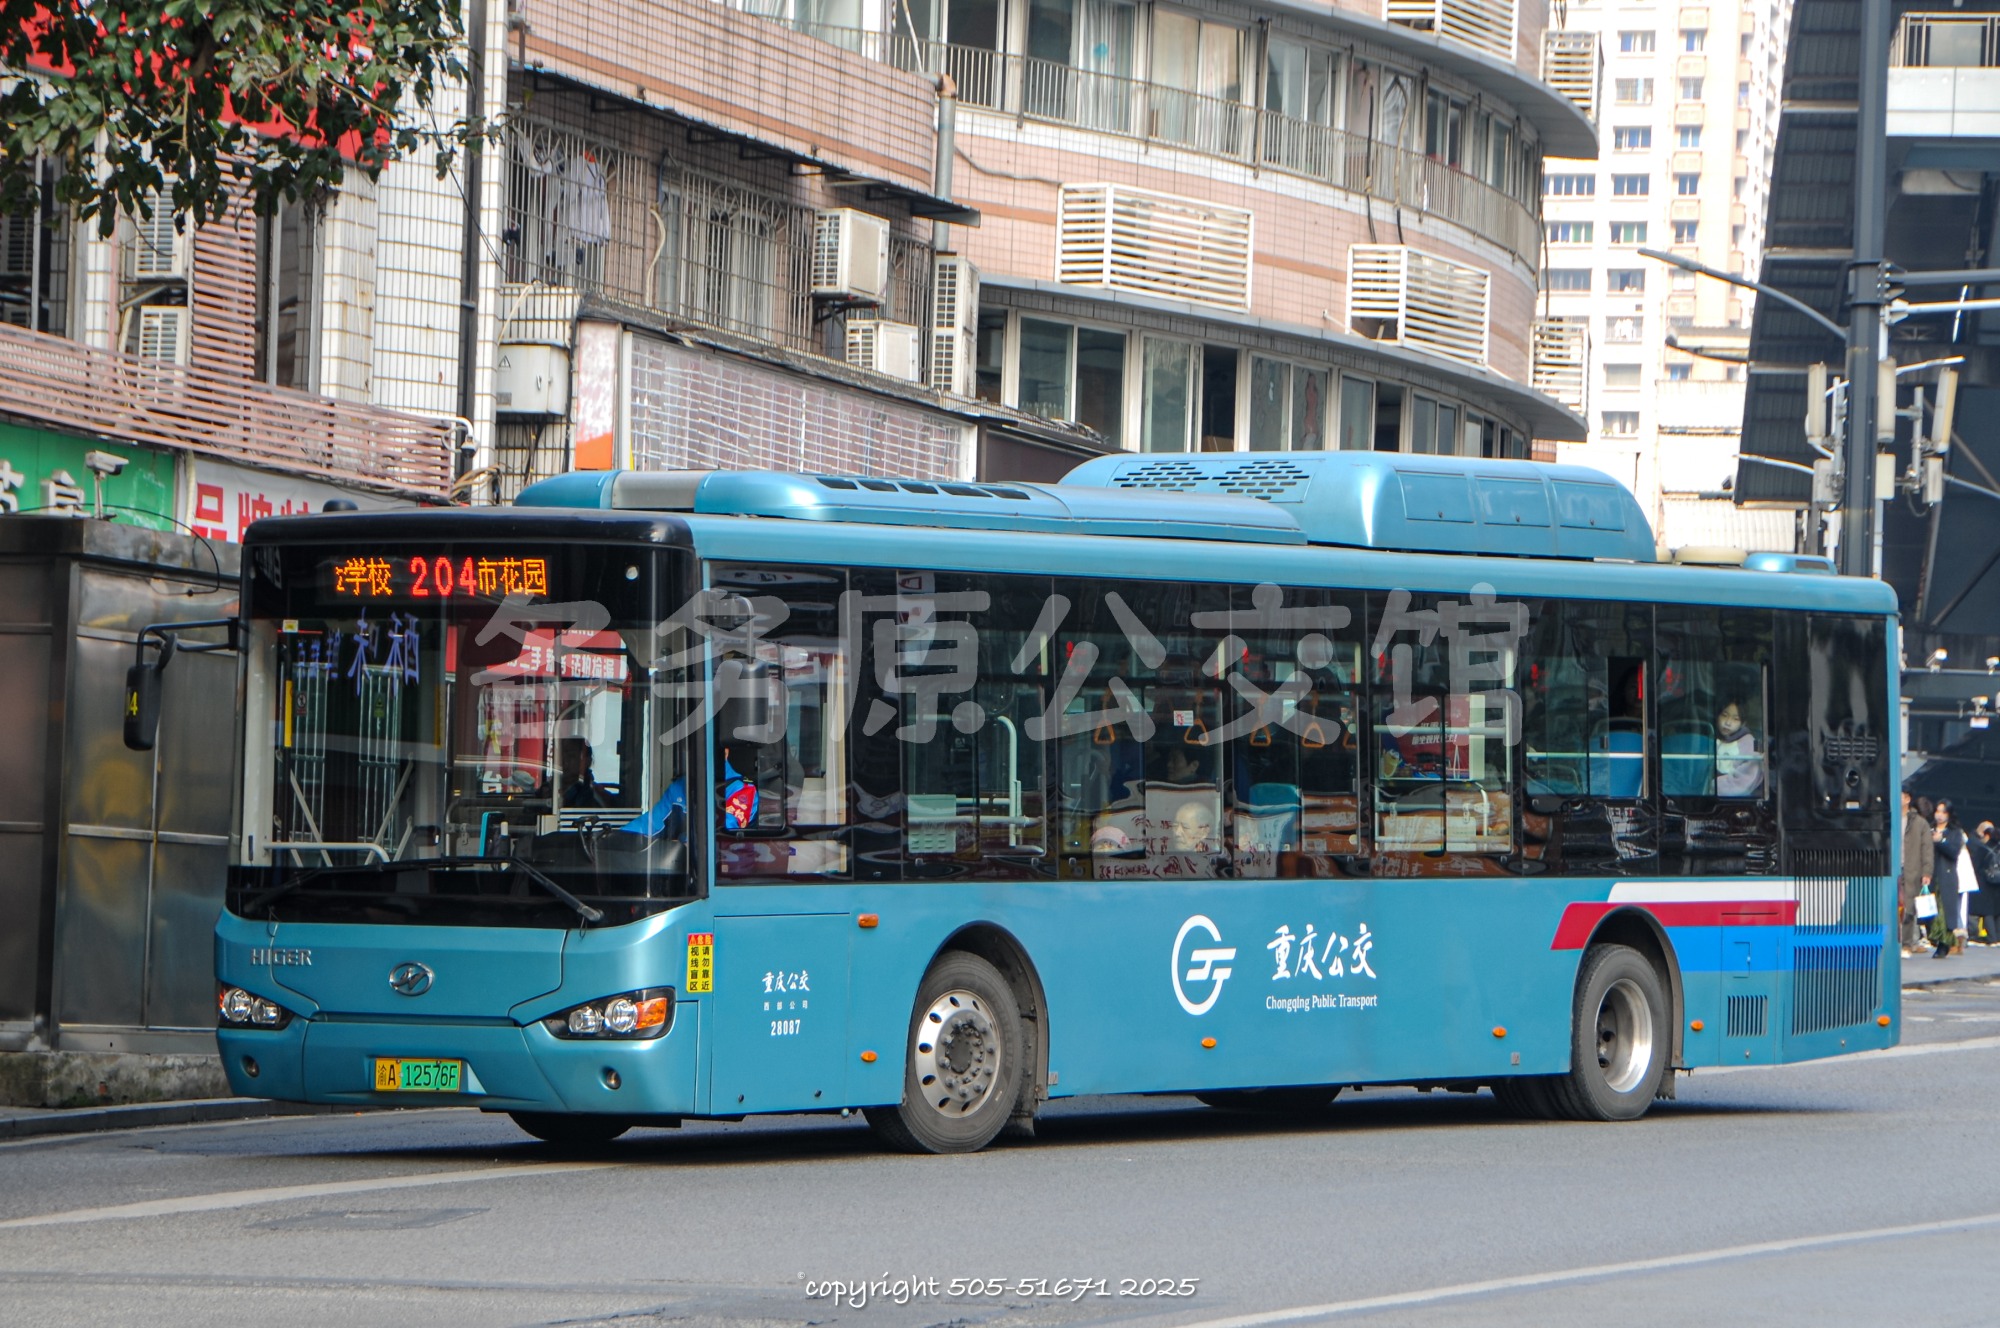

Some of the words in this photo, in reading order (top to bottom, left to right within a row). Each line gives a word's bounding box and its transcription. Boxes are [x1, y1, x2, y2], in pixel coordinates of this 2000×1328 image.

[192, 482, 309, 543] 品牌
[410, 556, 478, 597] 204
[478, 557, 547, 596] 市花园
[250, 949, 312, 966] HIGER
[690, 946, 699, 991] 视线盲区
[702, 946, 710, 991] 请勿靠近
[1266, 922, 1377, 981] 重庆公交
[762, 970, 811, 993] 重庆公交
[1266, 995, 1310, 1013] Chongqing
[1312, 994, 1337, 1009] Public
[1338, 994, 1378, 1010] Transport
[770, 1019, 801, 1036] 28087
